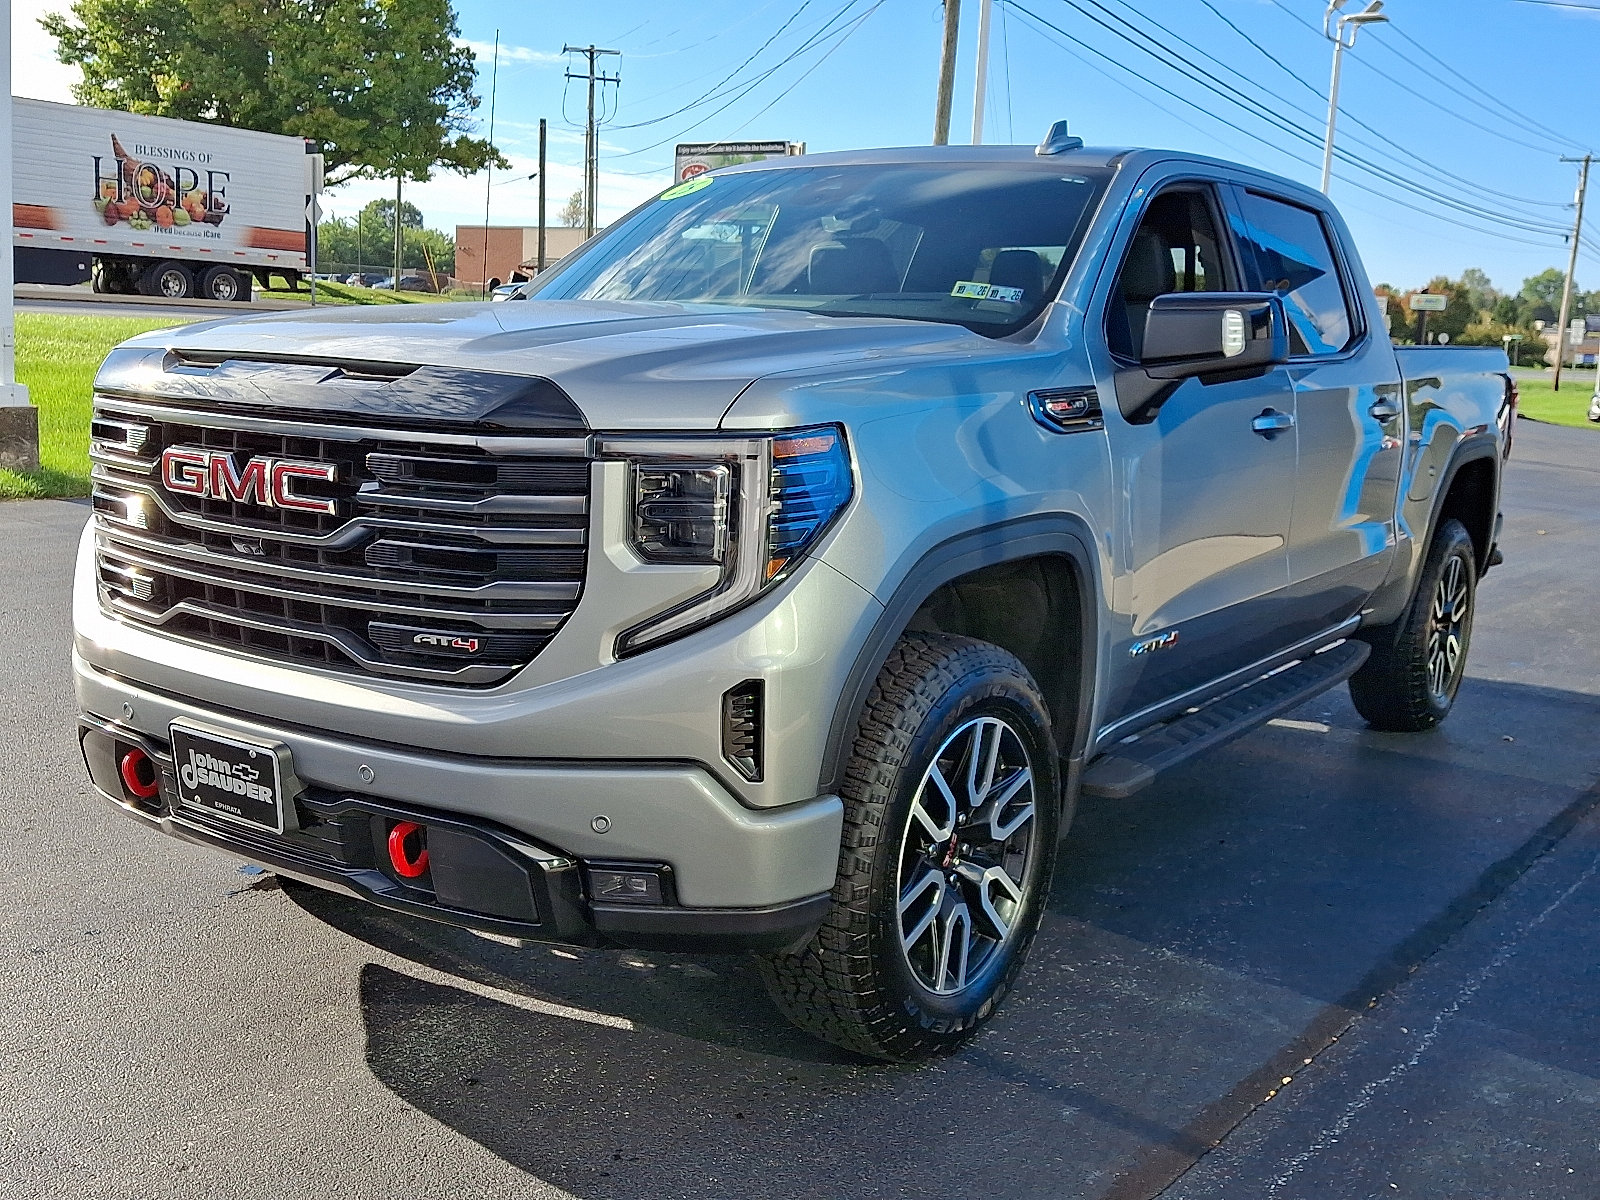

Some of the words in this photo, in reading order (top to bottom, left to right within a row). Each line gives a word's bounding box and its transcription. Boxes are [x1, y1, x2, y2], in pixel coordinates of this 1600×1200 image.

[135, 144, 195, 161] BLESSINGS
[198, 152, 213, 164] OF
[91, 155, 231, 215] HOPE
[173, 227, 202, 238] because
[203, 230, 221, 239] iCare
[162, 444, 338, 516] GMC
[413, 633, 479, 653] AT4
[181, 748, 231, 790] John
[197, 767, 274, 804] SAUDER
[214, 801, 242, 815] EPHRATA
